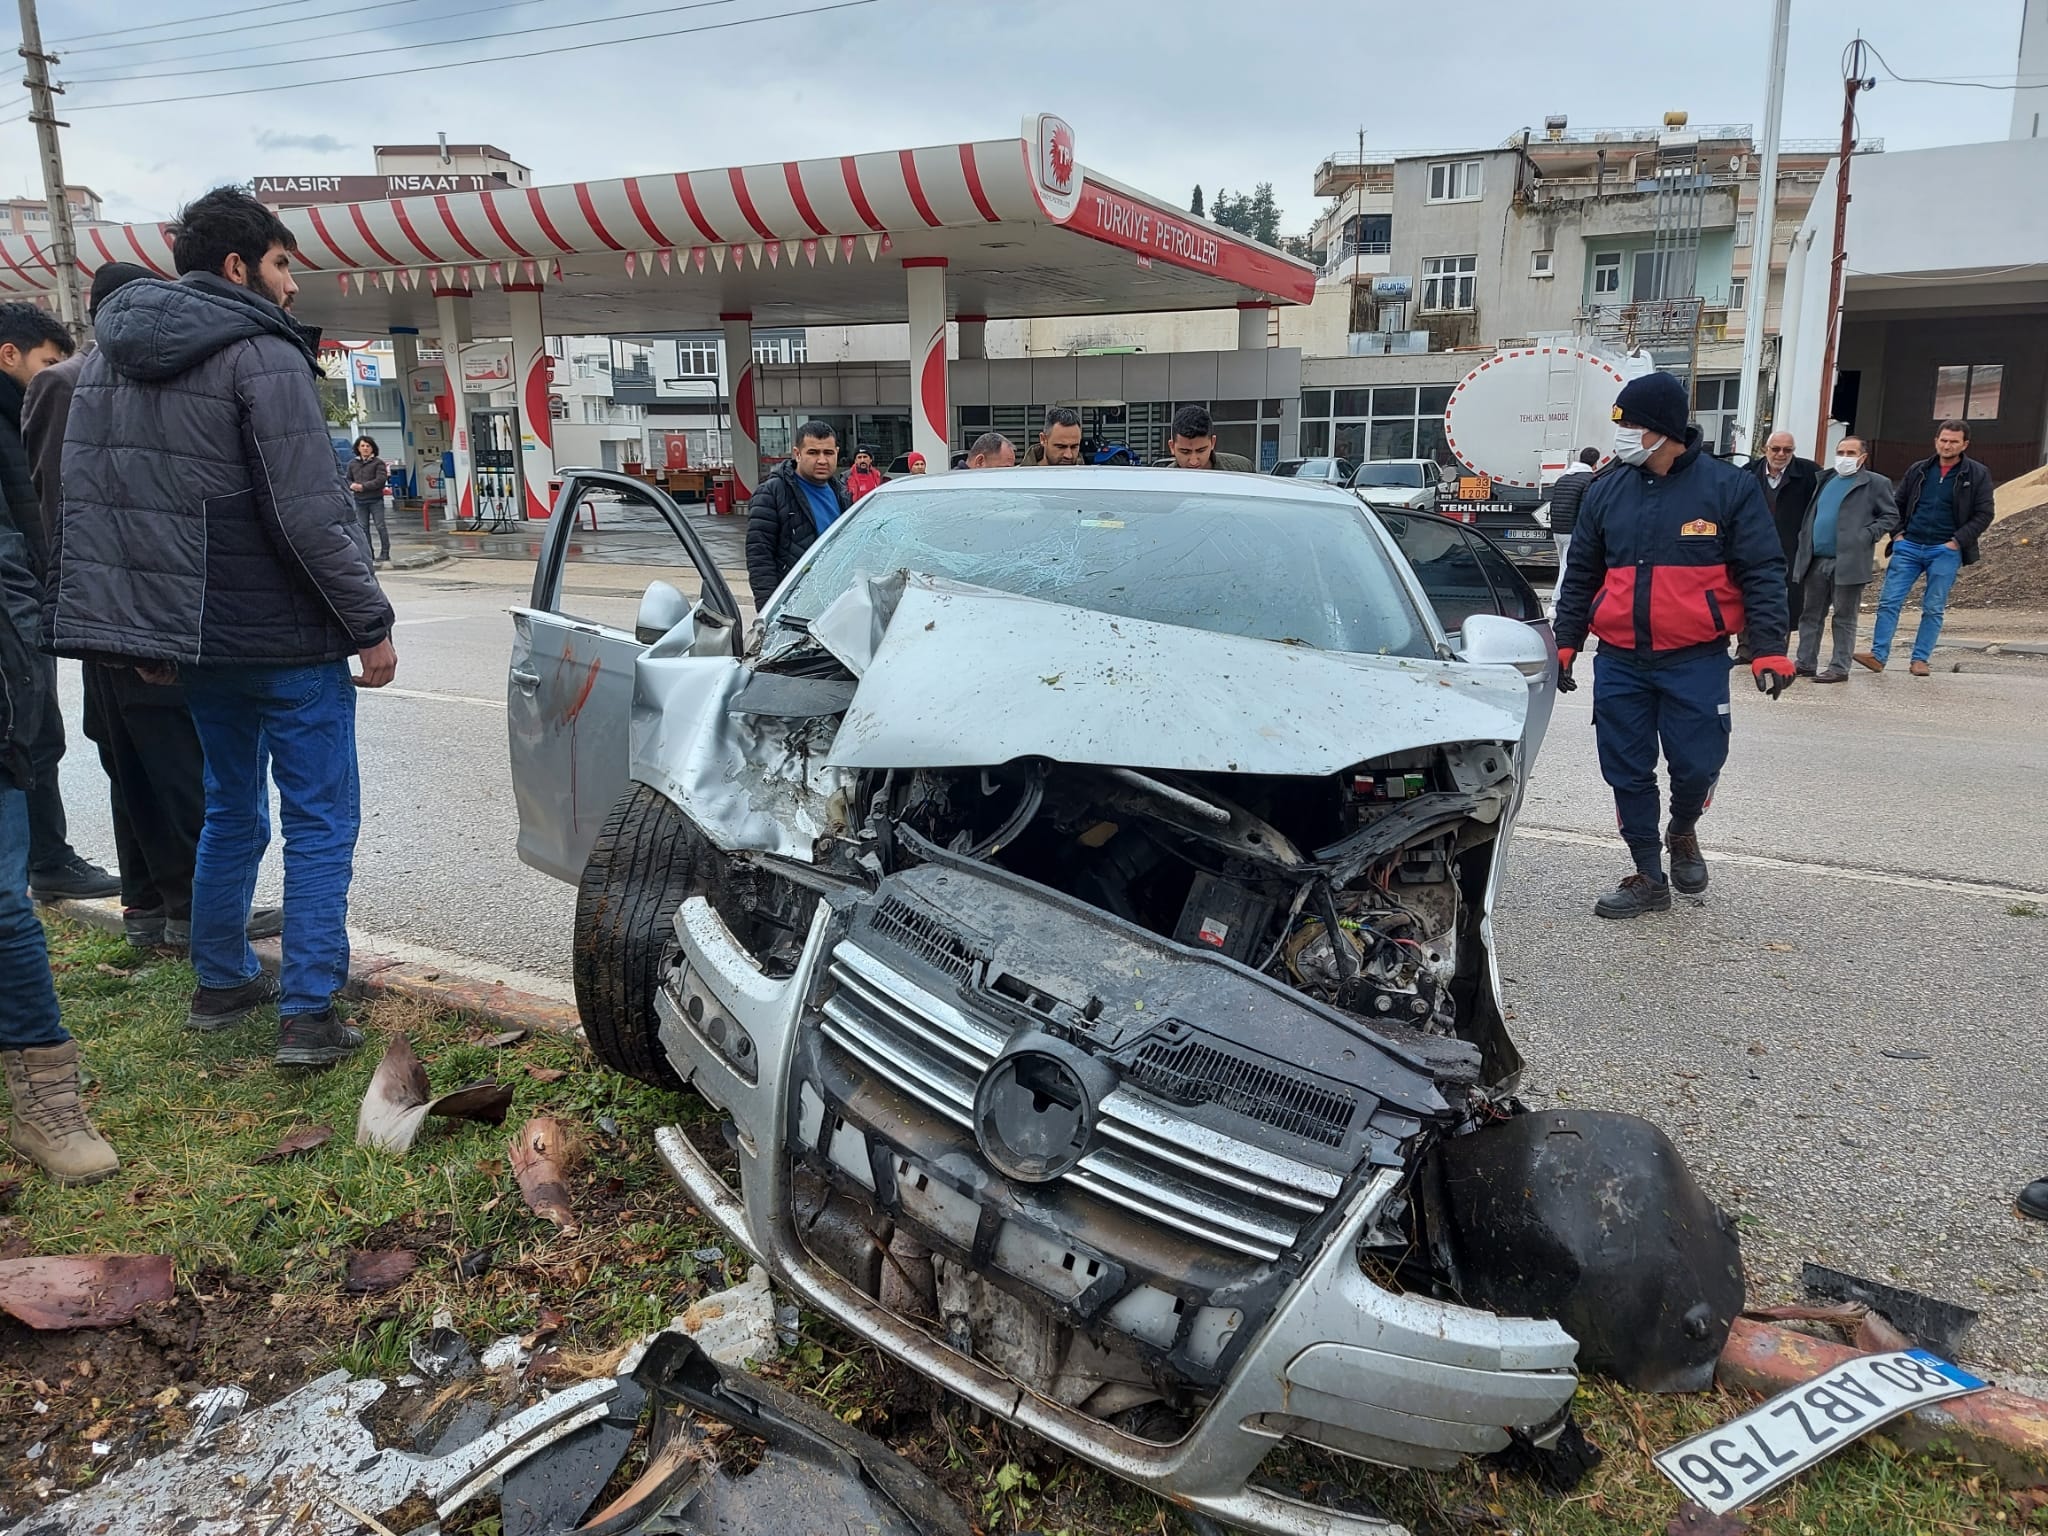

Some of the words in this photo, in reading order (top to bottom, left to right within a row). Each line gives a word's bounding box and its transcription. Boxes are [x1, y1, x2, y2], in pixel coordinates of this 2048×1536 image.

[259, 177, 341, 191] ALASIRT
[1096, 194, 1150, 243] TÜRKİYE
[1155, 220, 1218, 267] PETROLLERİ
[1461, 489, 1488, 498] 1203
[1476, 478, 1489, 487] 33
[1440, 502, 1513, 512] TEHLİKELİ
[1868, 1356, 1949, 1394] 80
[1769, 1371, 1887, 1446] ABZ
[1678, 1424, 1800, 1501] 756
